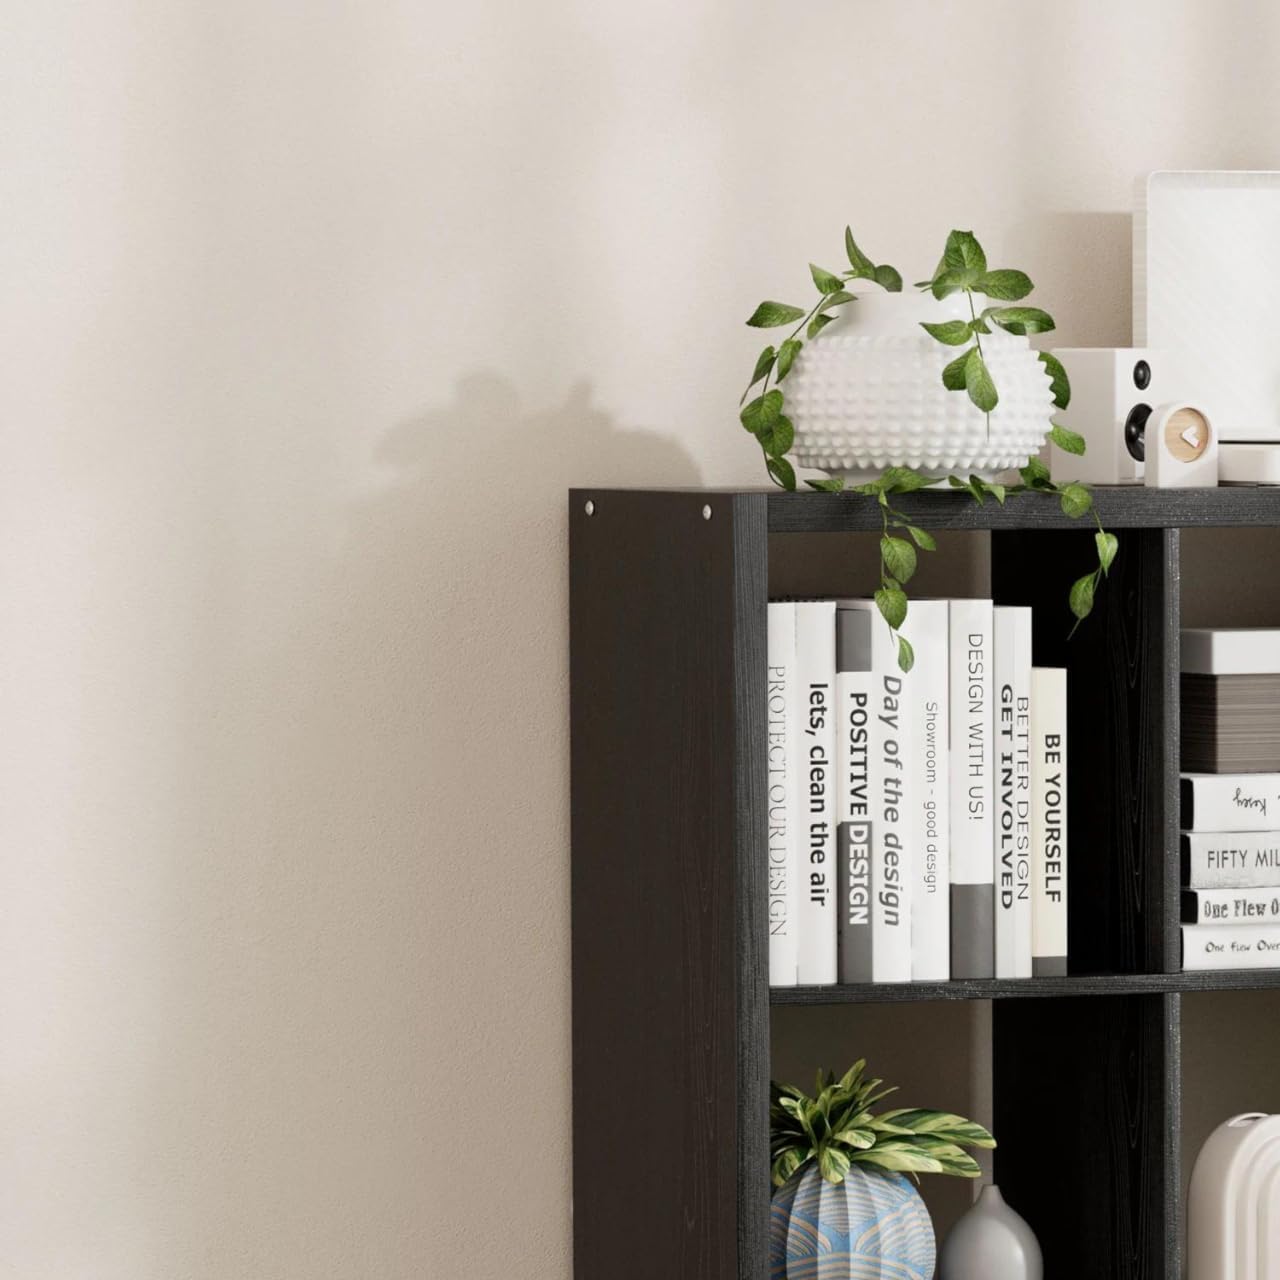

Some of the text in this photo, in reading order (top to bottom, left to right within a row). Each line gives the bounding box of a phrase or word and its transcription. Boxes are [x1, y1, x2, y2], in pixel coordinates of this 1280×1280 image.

[768, 666, 787, 936] PROTECT OUR DESIGN
[805, 683, 830, 906] lets, clean the air
[849, 692, 869, 925] POSITIVE DESIGN
[878, 675, 903, 927] Day of the design
[925, 701, 938, 783] Showroom
[968, 634, 984, 820] DESIGN WITH US!
[1001, 684, 1013, 909] GET INVOLVED
[1017, 696, 1029, 900] BETTER DESIGN
[1233, 787, 1266, 816] Kesey
[923, 801, 936, 839] good
[923, 844, 937, 893] design
[1044, 734, 1061, 903] BE YOURSELF
[1207, 850, 1248, 868] FIFTY
[1204, 900, 1228, 919] One
[1234, 899, 1266, 917] Flew
[1205, 941, 1225, 952] One
[1257, 939, 1280, 951] Over
